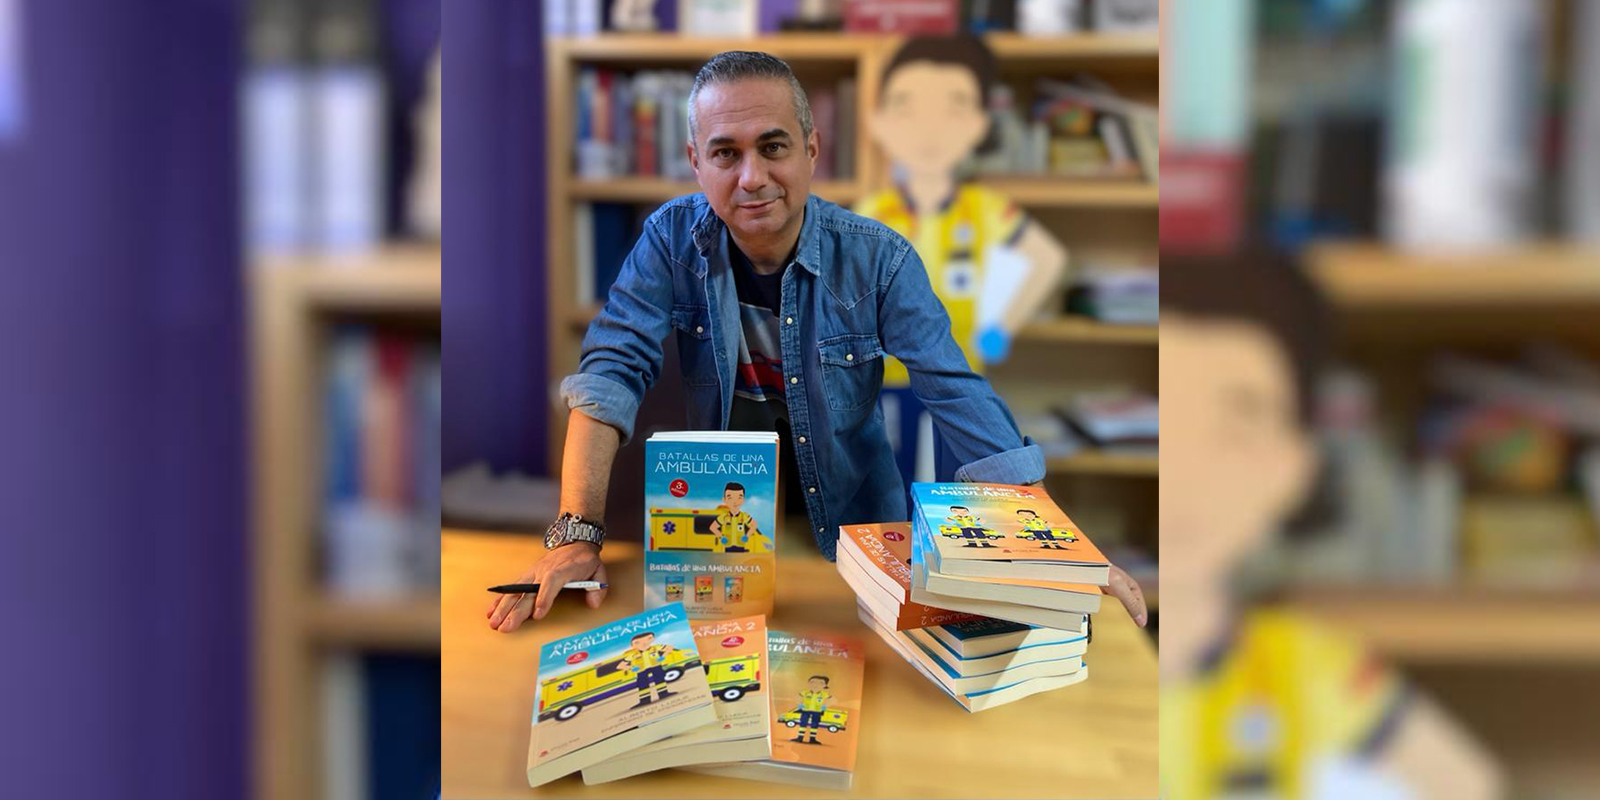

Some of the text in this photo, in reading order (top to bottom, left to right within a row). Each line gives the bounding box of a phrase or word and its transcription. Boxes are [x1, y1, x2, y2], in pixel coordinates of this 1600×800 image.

[659, 452, 765, 462] BATALLAS DE UNA
[681, 563, 691, 572] de
[708, 563, 762, 574] AMBULANCIA
[921, 615, 928, 626] 2
[745, 621, 756, 631] 2
